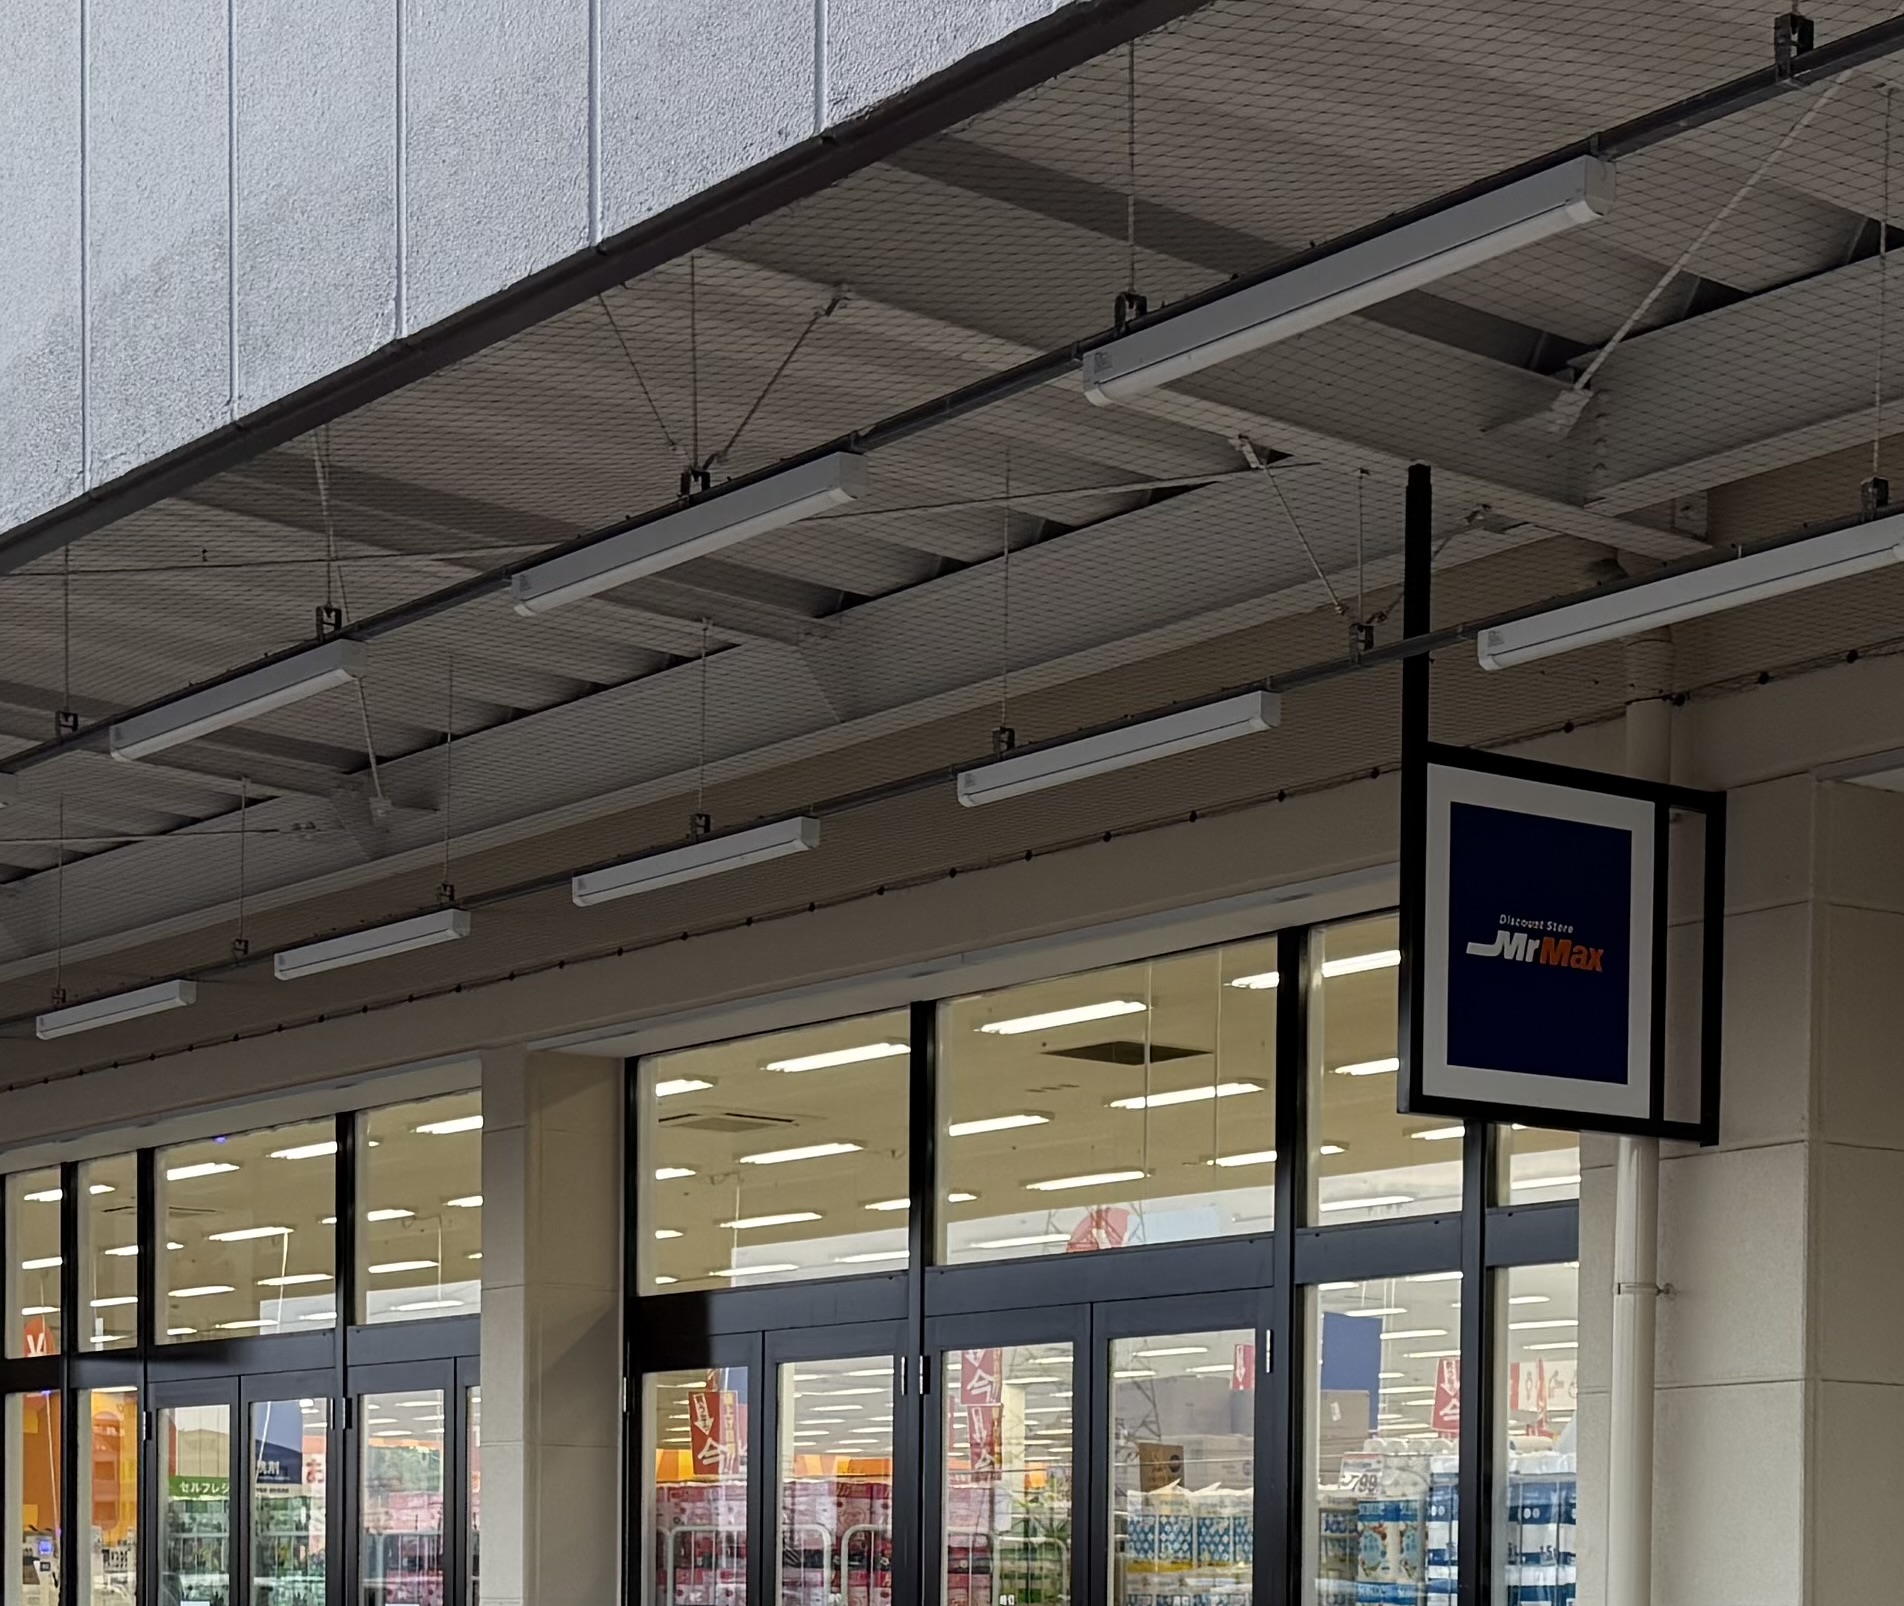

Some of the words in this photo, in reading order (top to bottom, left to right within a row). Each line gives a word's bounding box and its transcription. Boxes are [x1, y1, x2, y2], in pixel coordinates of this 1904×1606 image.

[1499, 914, 1544, 930] Discount
[1546, 921, 1574, 934] Store
[1466, 930, 1604, 973] MrMax
